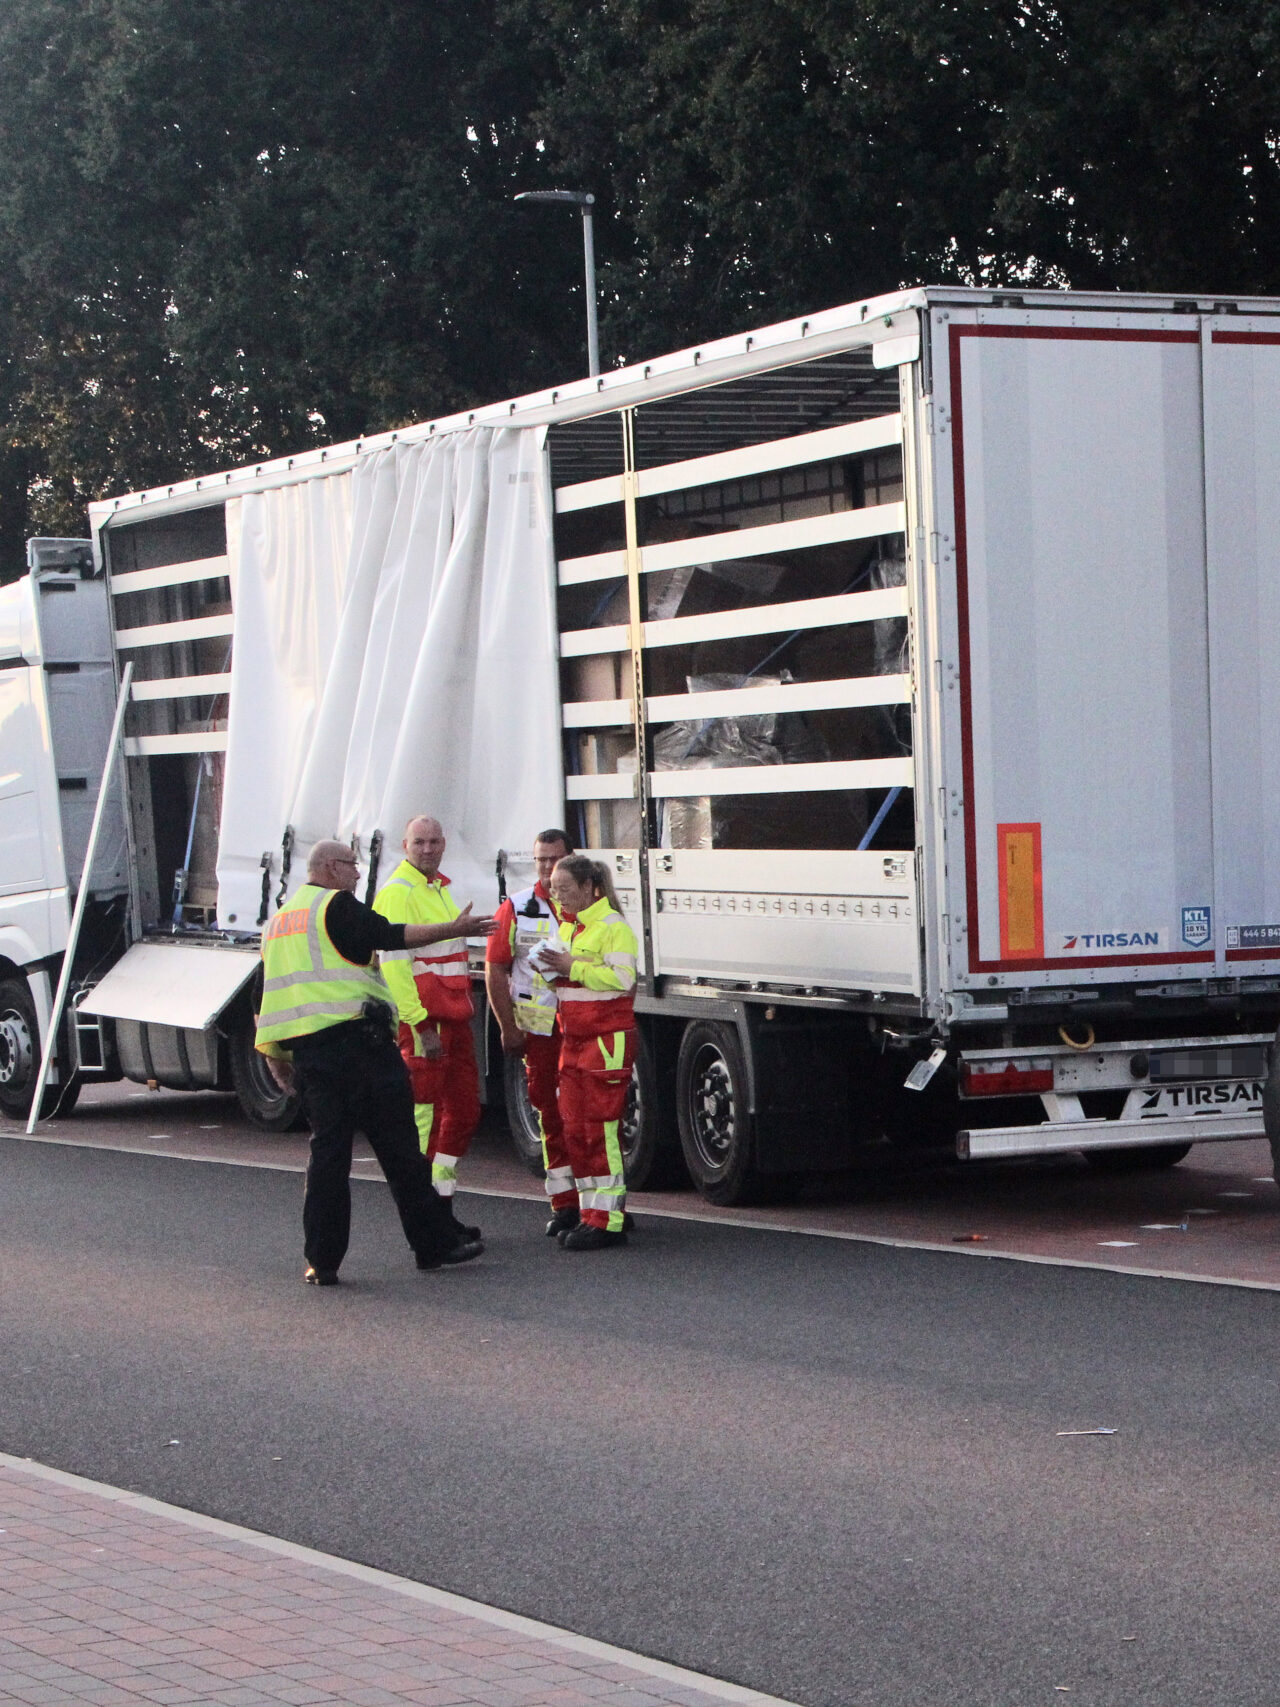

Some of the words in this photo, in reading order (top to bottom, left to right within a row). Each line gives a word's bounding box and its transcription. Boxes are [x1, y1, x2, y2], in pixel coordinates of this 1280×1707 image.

[1184, 910, 1207, 920] KTL
[1261, 929, 1266, 937] 5
[1082, 932, 1158, 948] TIRSAN
